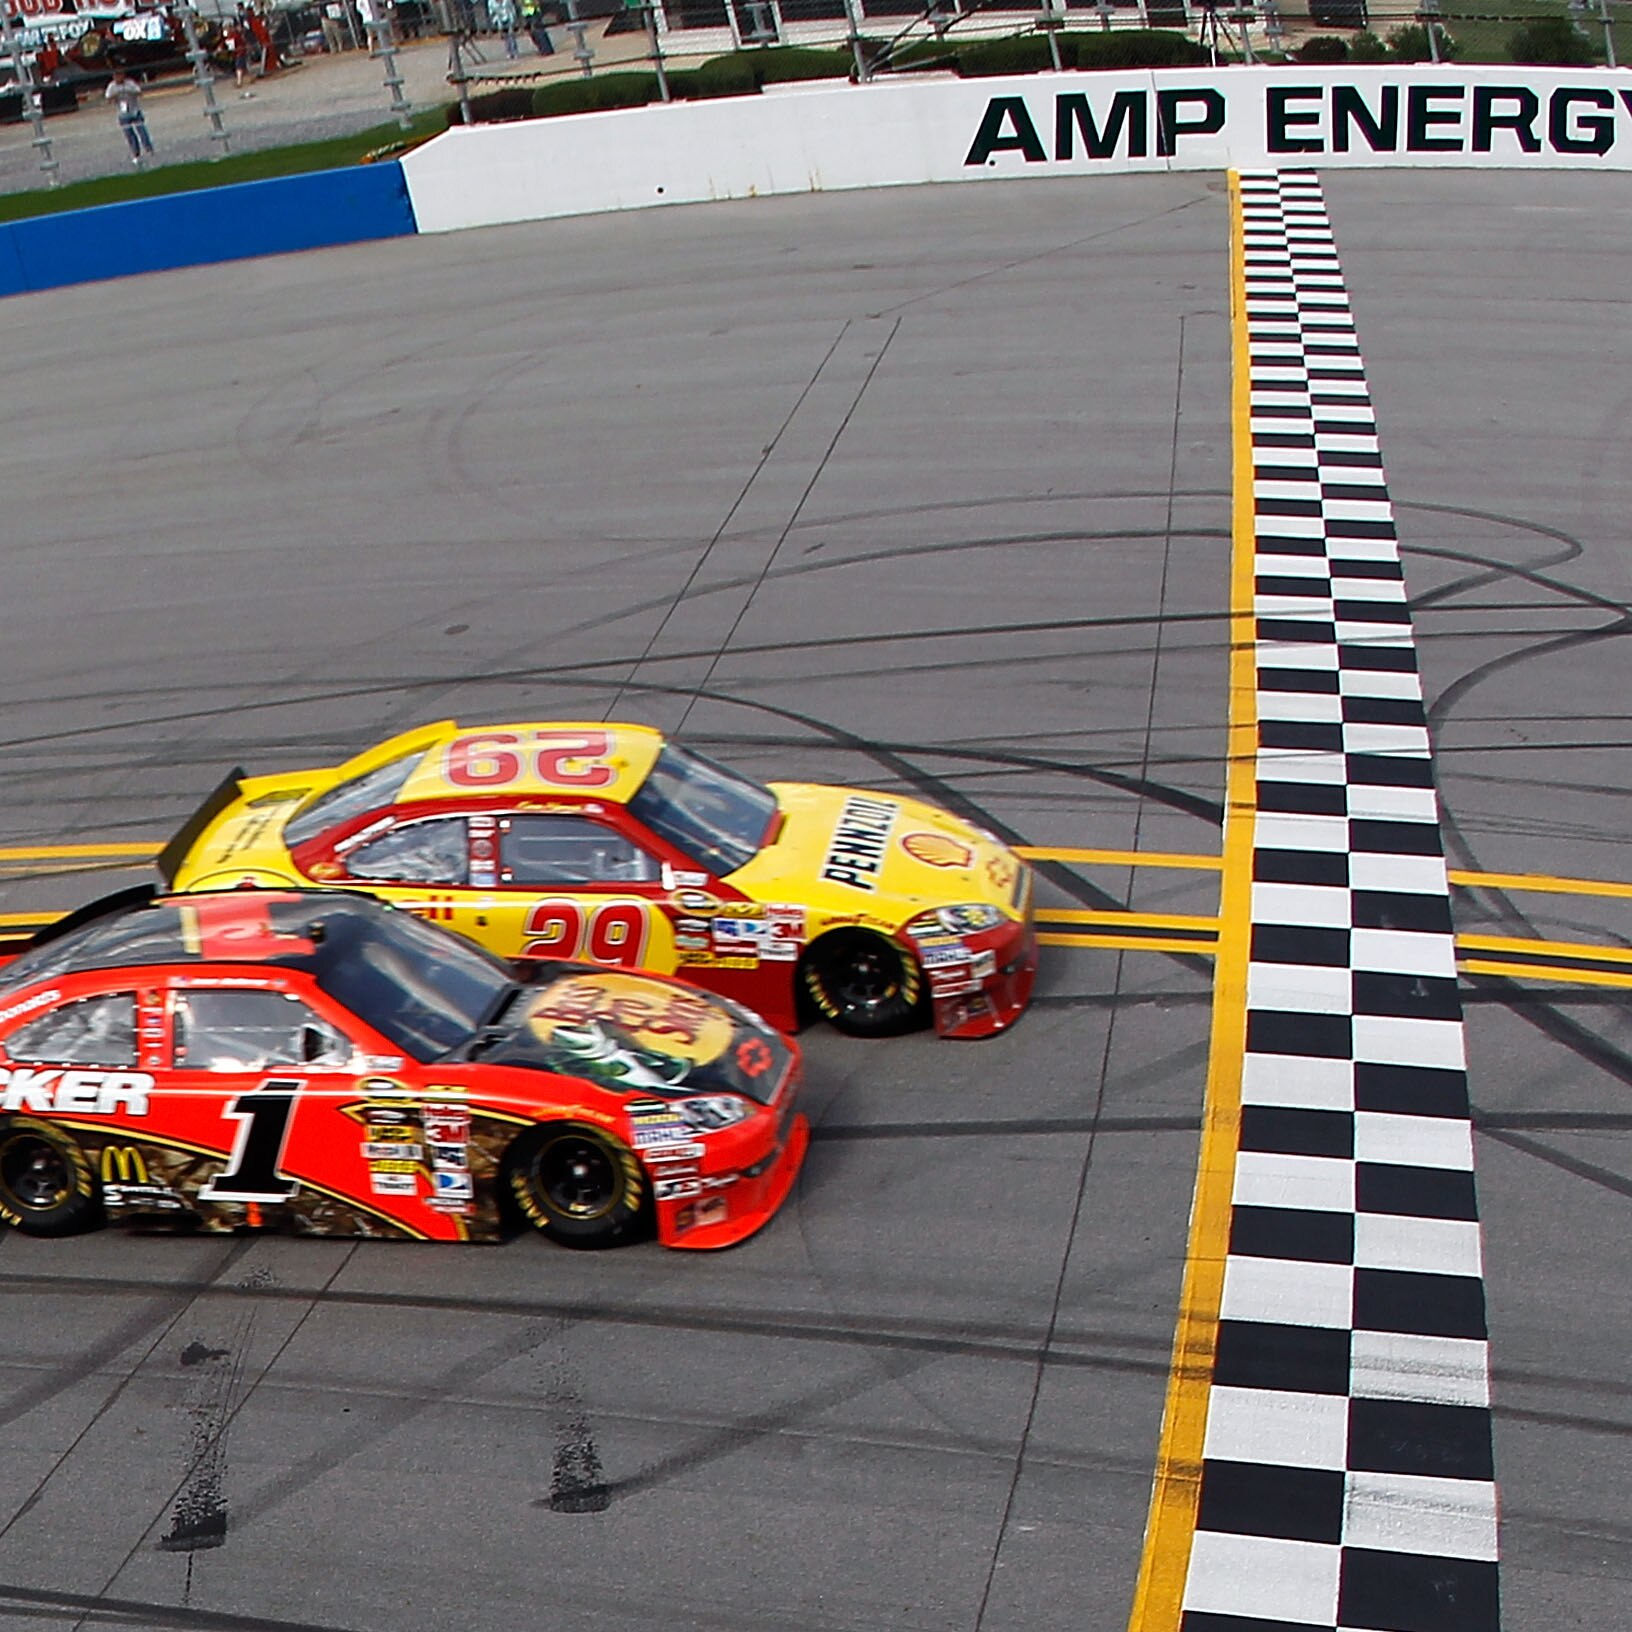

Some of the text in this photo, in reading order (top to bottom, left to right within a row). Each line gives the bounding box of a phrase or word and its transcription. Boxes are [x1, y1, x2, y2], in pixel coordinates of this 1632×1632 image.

[963, 84, 1632, 167] AMP ENERG
[447, 729, 617, 788] 29
[824, 797, 898, 890] PENNZOIL
[522, 896, 650, 968] 29
[197, 1077, 309, 1204] 1
